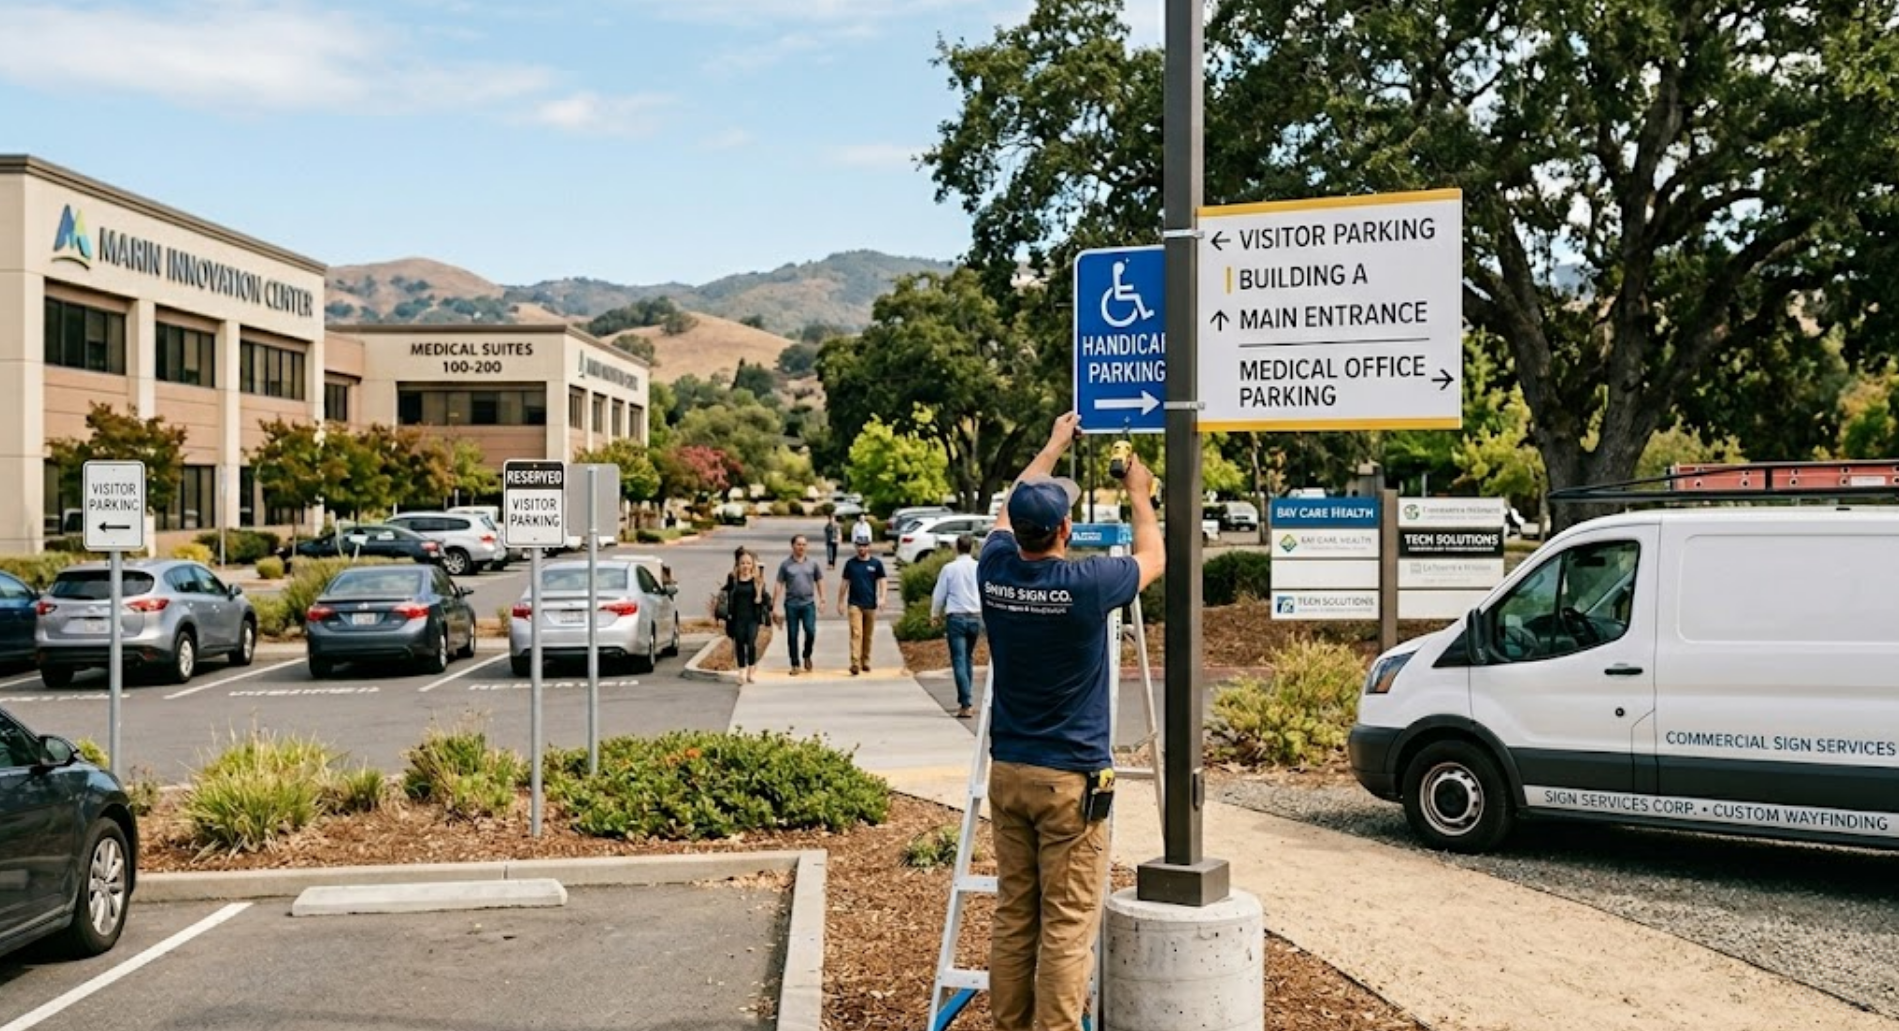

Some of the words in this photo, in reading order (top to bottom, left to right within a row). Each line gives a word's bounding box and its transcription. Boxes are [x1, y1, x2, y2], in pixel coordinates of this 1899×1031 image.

[1239, 225, 1326, 251] VISITOR
[1333, 217, 1436, 245] PARKING
[99, 226, 161, 277] MARIN
[166, 247, 262, 305] INNOVATION
[264, 279, 313, 318] CENTER
[1239, 264, 1346, 290] BUILDING
[1351, 263, 1368, 285] A
[1239, 307, 1297, 330] MAIN
[1304, 301, 1428, 328] ENTRANCE
[410, 342, 478, 356] MEDICAL
[482, 342, 534, 356] SUITES
[442, 360, 502, 374] 100-200
[1088, 360, 1166, 384] PARKING
[1239, 358, 1338, 381] MEDICAL
[1344, 355, 1426, 379] OFFICE
[1239, 384, 1337, 408] PARKING
[506, 470, 562, 485] RESERVED
[92, 482, 136, 496] VISITOR
[88, 498, 139, 511] PARKING
[512, 498, 557, 511] VISITOR
[1276, 506, 1297, 519] BAY
[1299, 507, 1329, 519] CARE
[1331, 506, 1374, 519] HEALTH
[510, 513, 560, 528] PARKING
[1404, 533, 1434, 545] TECH
[1436, 533, 1499, 546] SOLUTIONS
[1017, 587, 1047, 602] SIGN
[1049, 589, 1073, 602] CO.
[1665, 730, 1769, 750] COMMERCIAL
[1773, 736, 1812, 752] SIGN
[1816, 738, 1896, 757] SERVICES
[1544, 790, 1578, 805] SIGN
[1581, 793, 1649, 812] SERVICES
[1652, 799, 1698, 816] CORP.
[1712, 803, 1780, 823] CUSTOM
[1783, 808, 1889, 831] WAYFINDING
